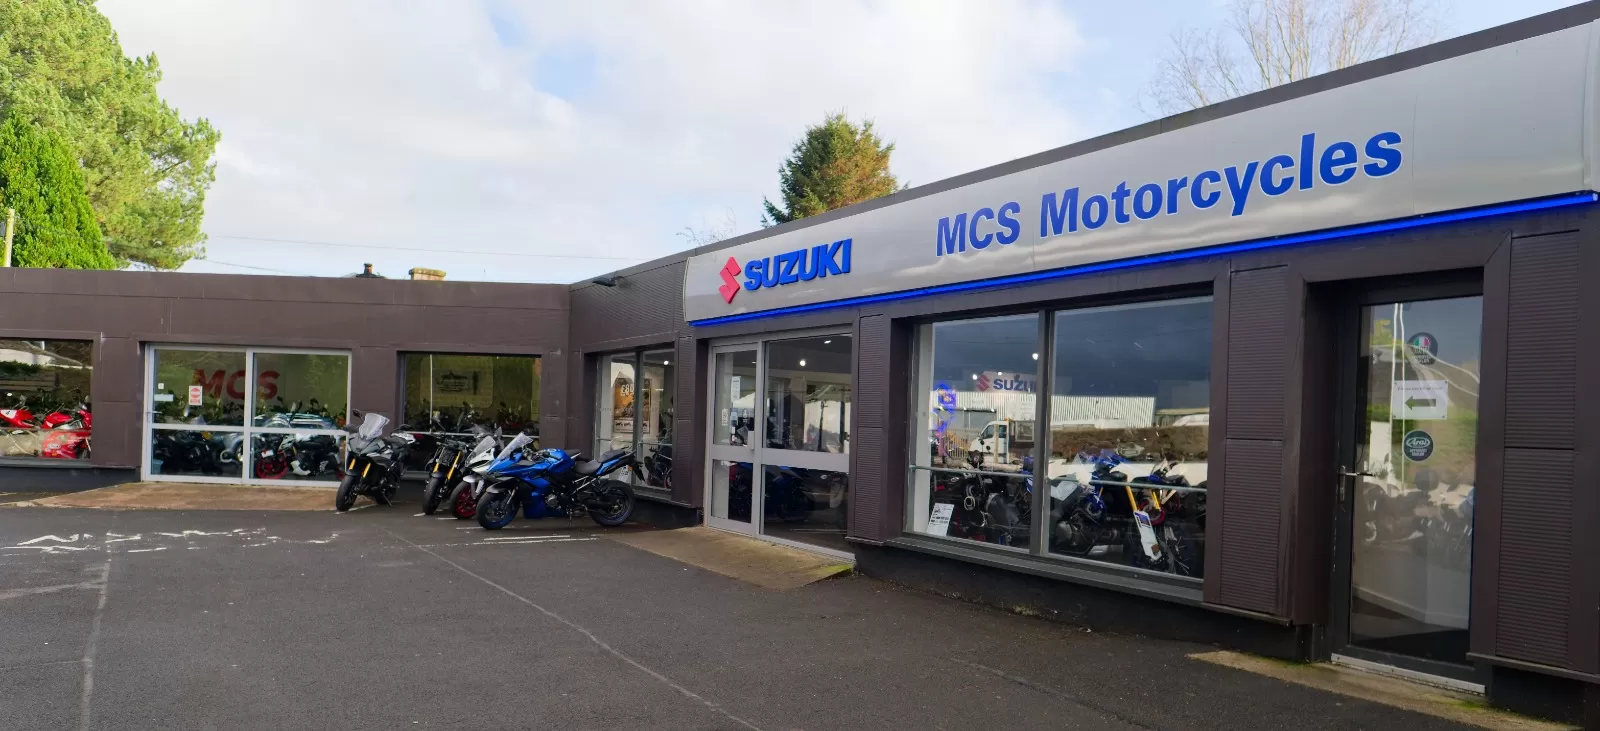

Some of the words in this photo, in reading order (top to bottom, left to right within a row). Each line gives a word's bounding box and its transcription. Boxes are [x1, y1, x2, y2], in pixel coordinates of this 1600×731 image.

[936, 201, 1021, 257] MCS
[1039, 131, 1403, 238] Motorcycles
[744, 238, 852, 291] SUZUKI
[192, 368, 280, 400] MCS
[992, 378, 1037, 392] SUZU
[1408, 438, 1428, 446] Arai
